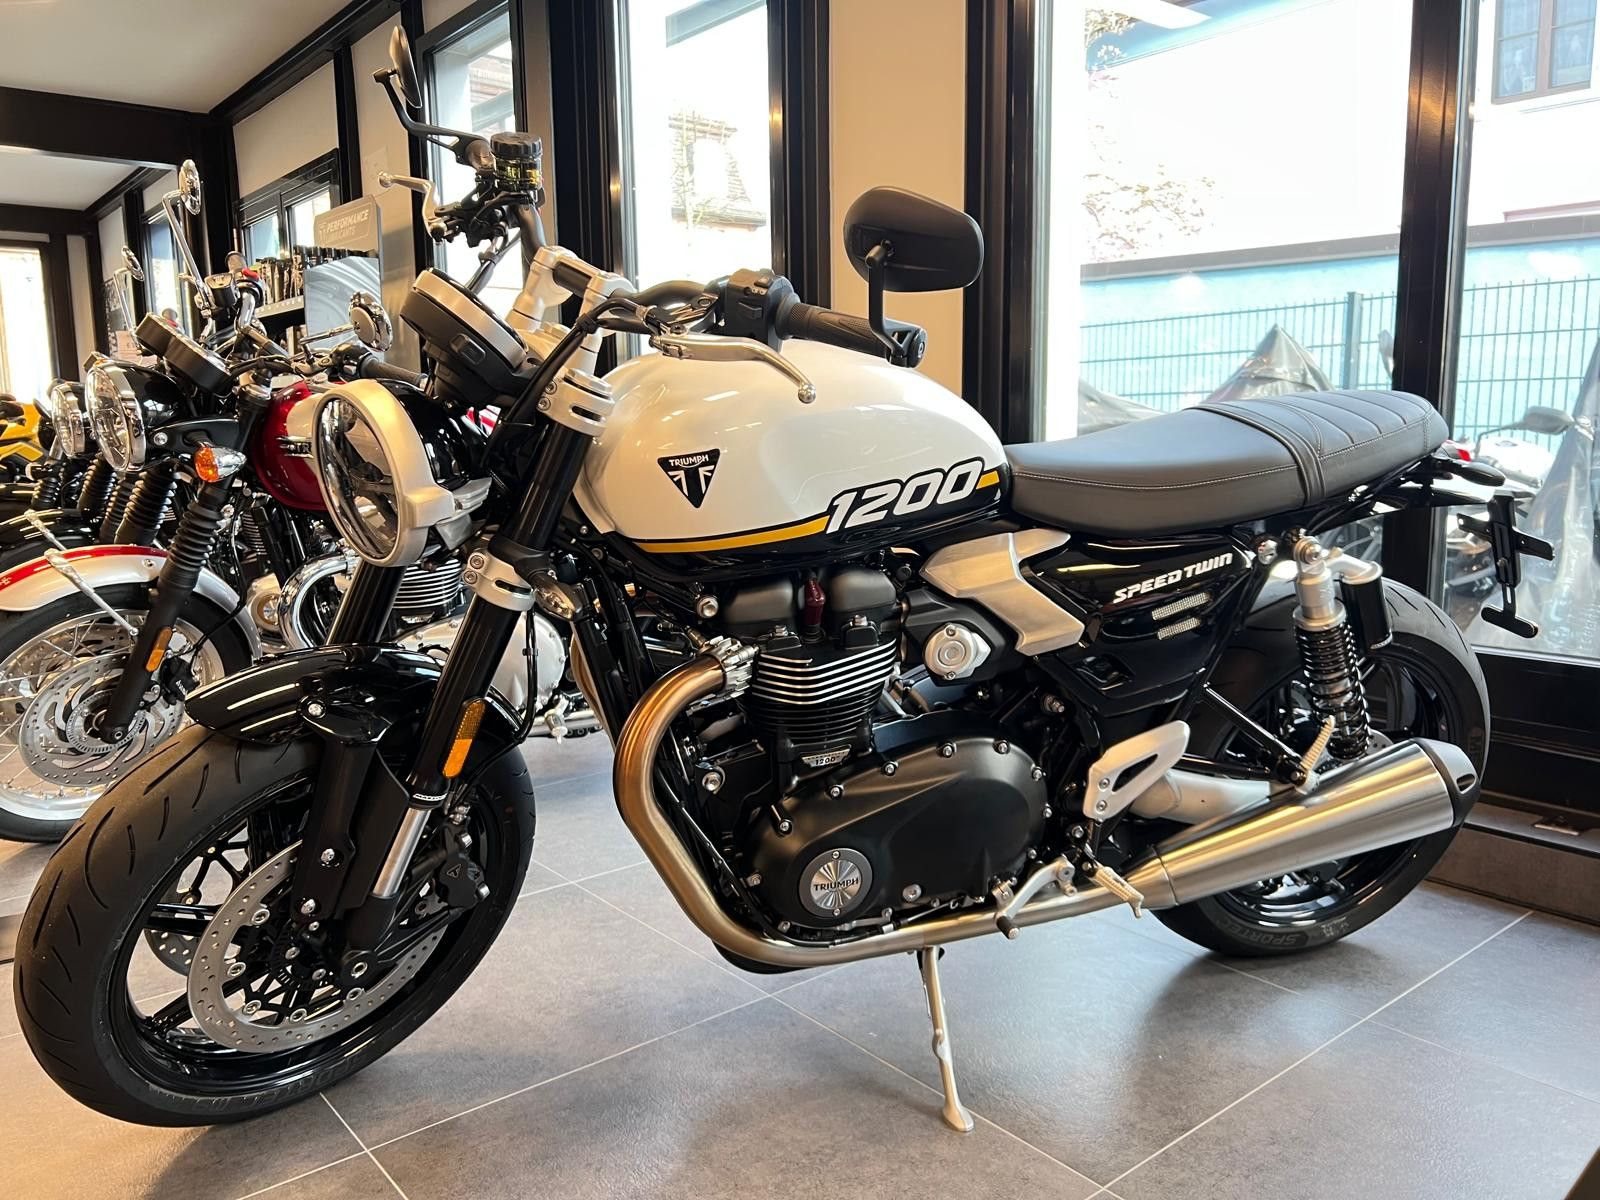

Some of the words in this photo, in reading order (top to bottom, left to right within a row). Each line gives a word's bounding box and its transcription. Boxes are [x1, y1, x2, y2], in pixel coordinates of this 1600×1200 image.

[326, 209, 369, 233] PERFORMANCE
[668, 454, 709, 467] TRIUMPH
[825, 459, 984, 534] 1200
[1112, 569, 1182, 604] SPEED
[1183, 552, 1233, 578] TWIN
[815, 756, 836, 766] 1200
[813, 877, 859, 892] TRIUMPH
